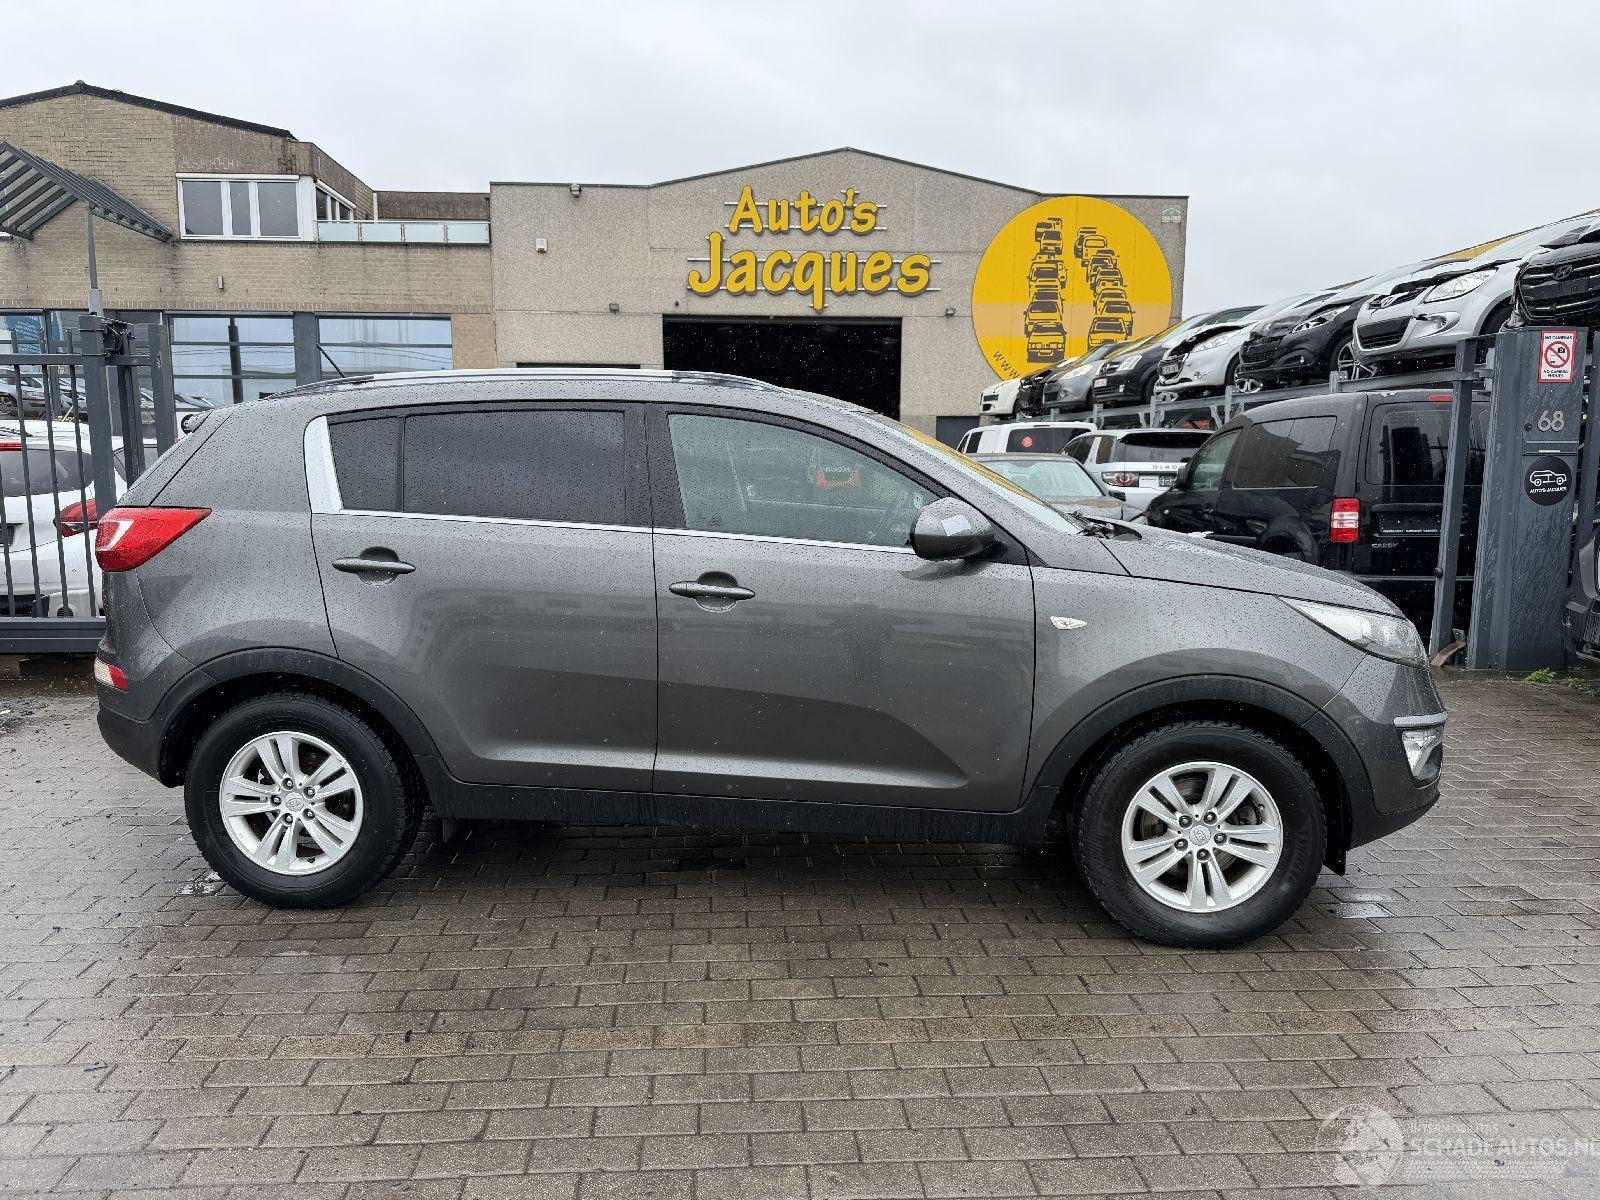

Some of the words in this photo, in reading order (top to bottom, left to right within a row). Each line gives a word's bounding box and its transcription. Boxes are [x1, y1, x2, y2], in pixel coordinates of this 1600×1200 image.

[726, 184, 879, 236] Auto's
[687, 231, 932, 310] Jacques
[1537, 410, 1565, 432] 68
